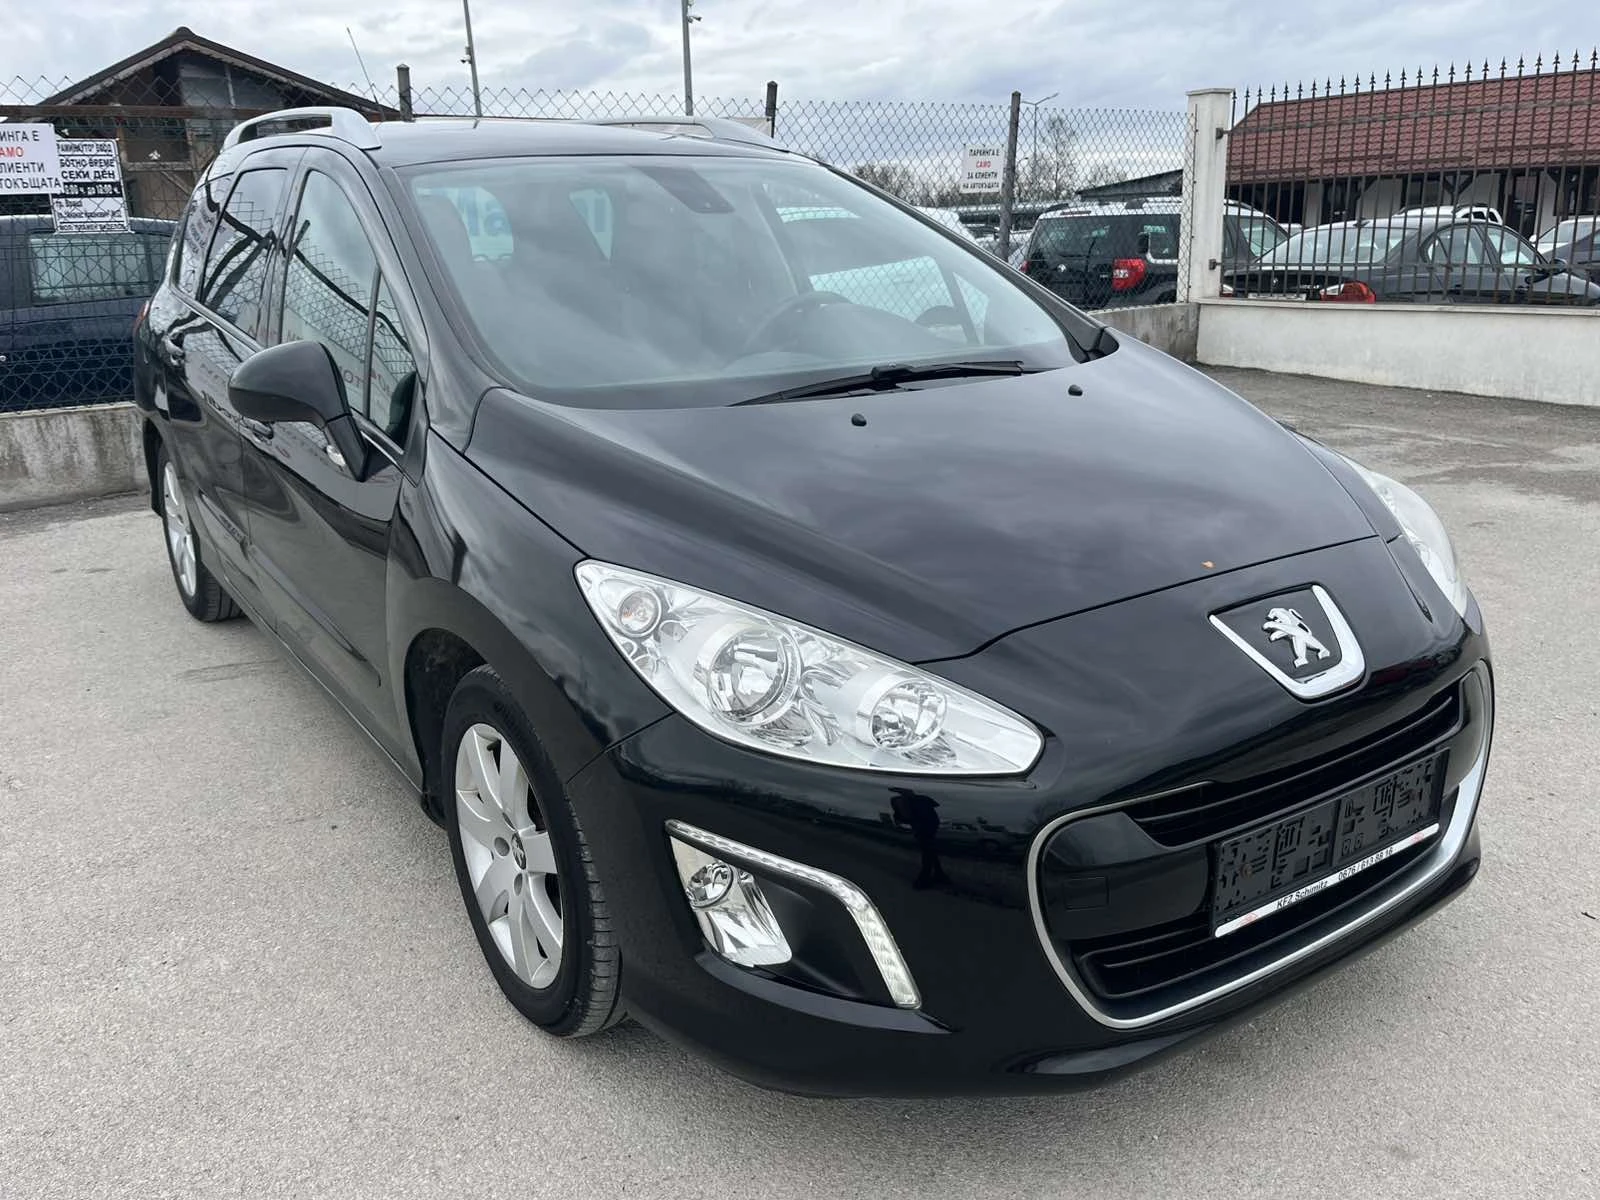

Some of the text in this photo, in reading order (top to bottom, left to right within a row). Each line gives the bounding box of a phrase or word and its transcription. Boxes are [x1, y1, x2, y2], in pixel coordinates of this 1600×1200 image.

[32, 130, 39, 141] Е
[975, 160, 992, 168] САМО
[93, 170, 116, 180] ДЕН
[1276, 896, 1293, 910] KFZ
